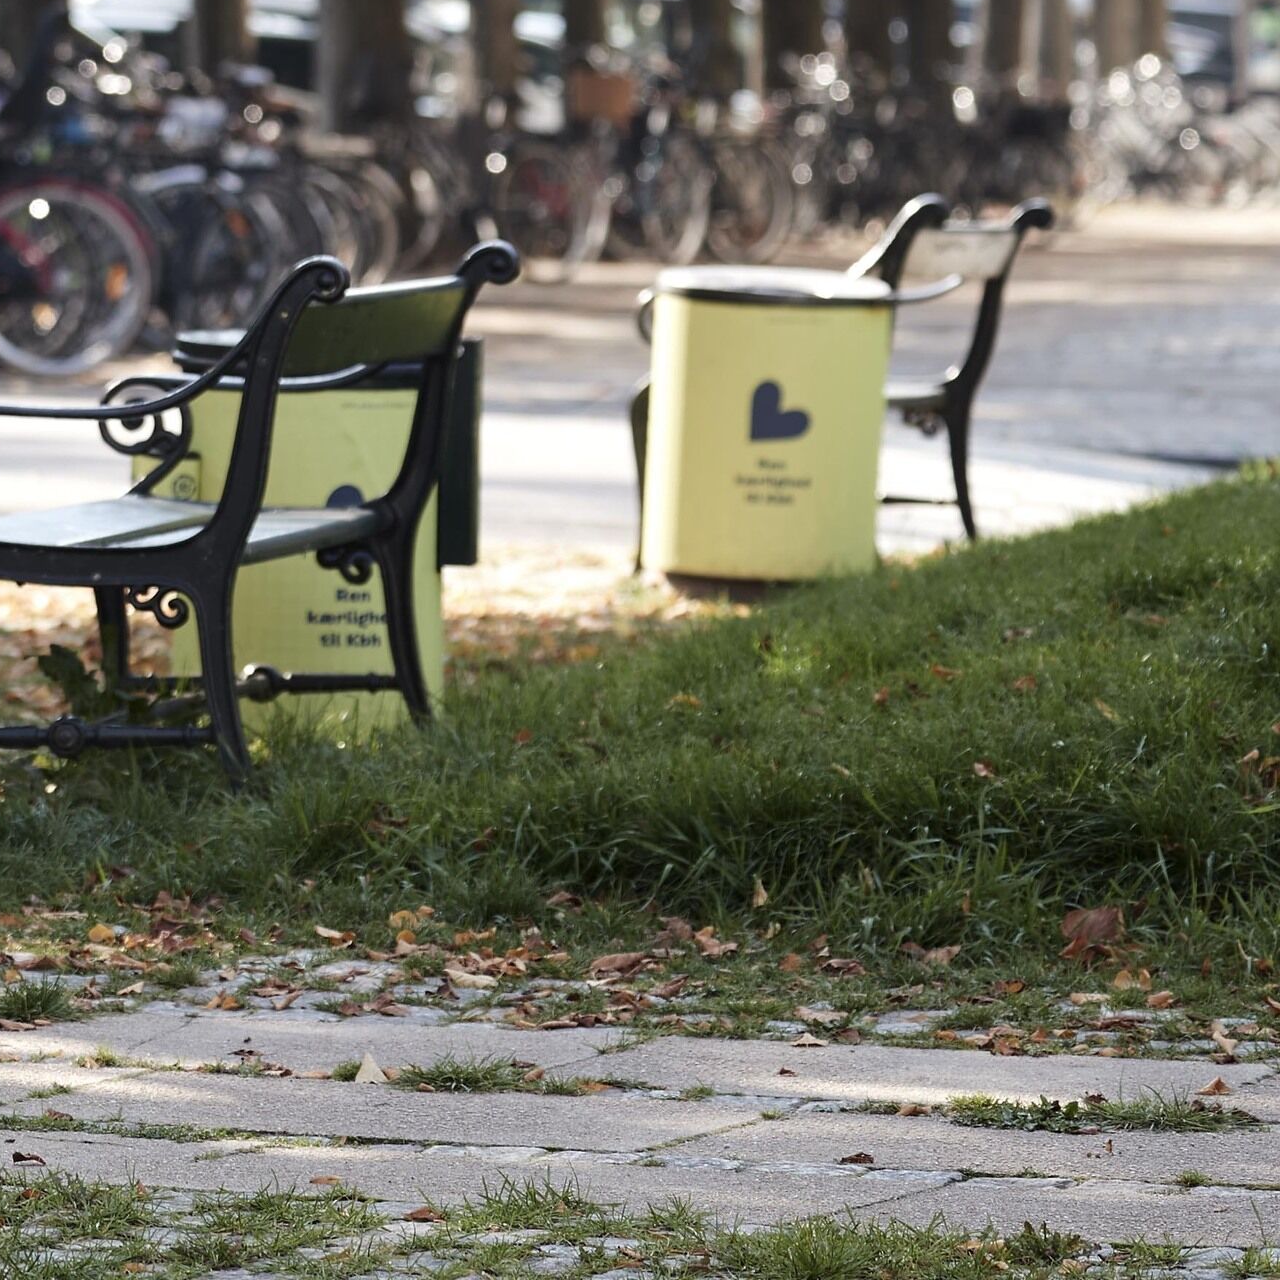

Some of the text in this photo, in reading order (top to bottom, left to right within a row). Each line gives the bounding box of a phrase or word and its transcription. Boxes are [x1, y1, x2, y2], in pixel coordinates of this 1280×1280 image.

[336, 589, 369, 602] Ren
[306, 612, 388, 628] kærlighe
[347, 635, 381, 647] Kbh
